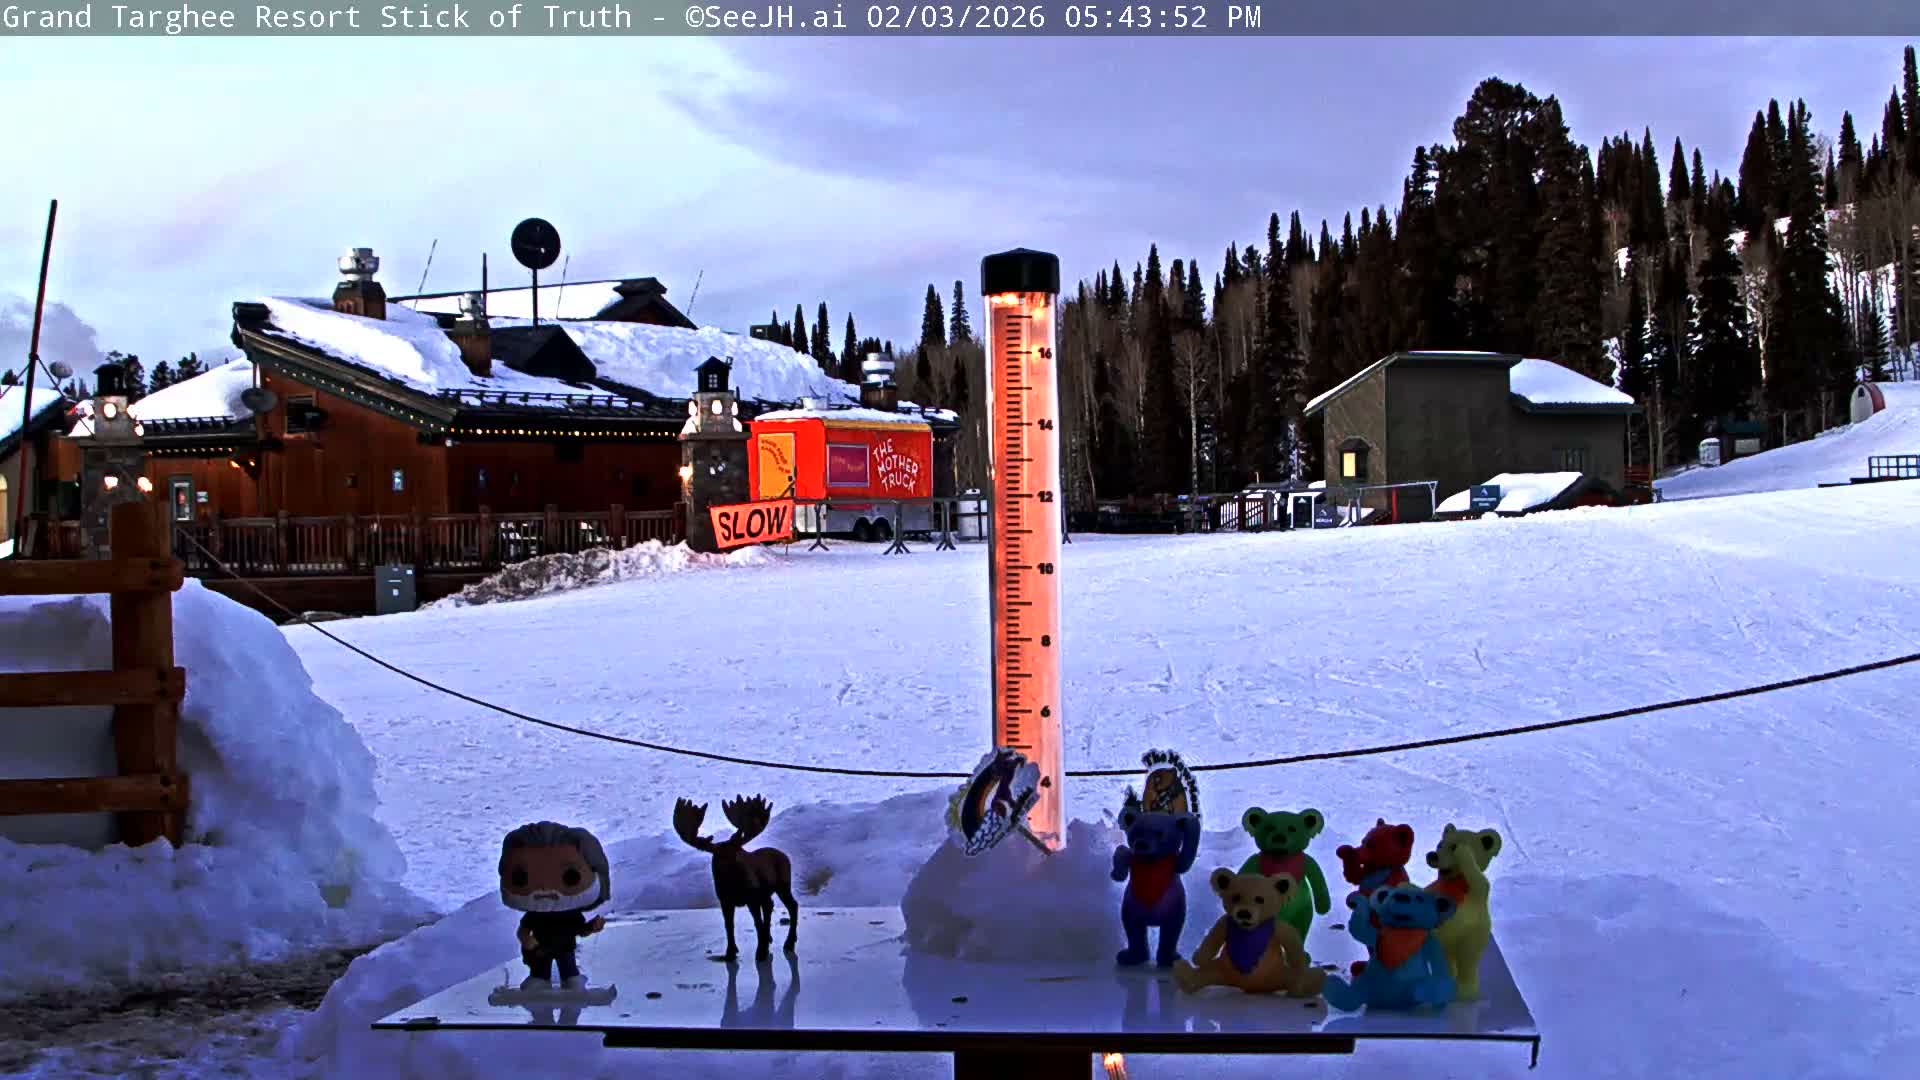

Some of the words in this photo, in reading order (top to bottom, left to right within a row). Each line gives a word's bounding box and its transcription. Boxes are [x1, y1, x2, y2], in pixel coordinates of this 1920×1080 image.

[1037, 346, 1053, 360] 16
[1037, 418, 1054, 431] 14
[872, 438, 894, 463] THE
[877, 454, 919, 478] MOTHER
[881, 471, 916, 495] TRUCK
[1037, 490, 1054, 503] 12
[717, 504, 789, 541] SLOW
[1037, 562, 1054, 575] 10
[1040, 634, 1051, 647] 8
[1040, 705, 1051, 718] 6
[1040, 775, 1051, 788] 4
